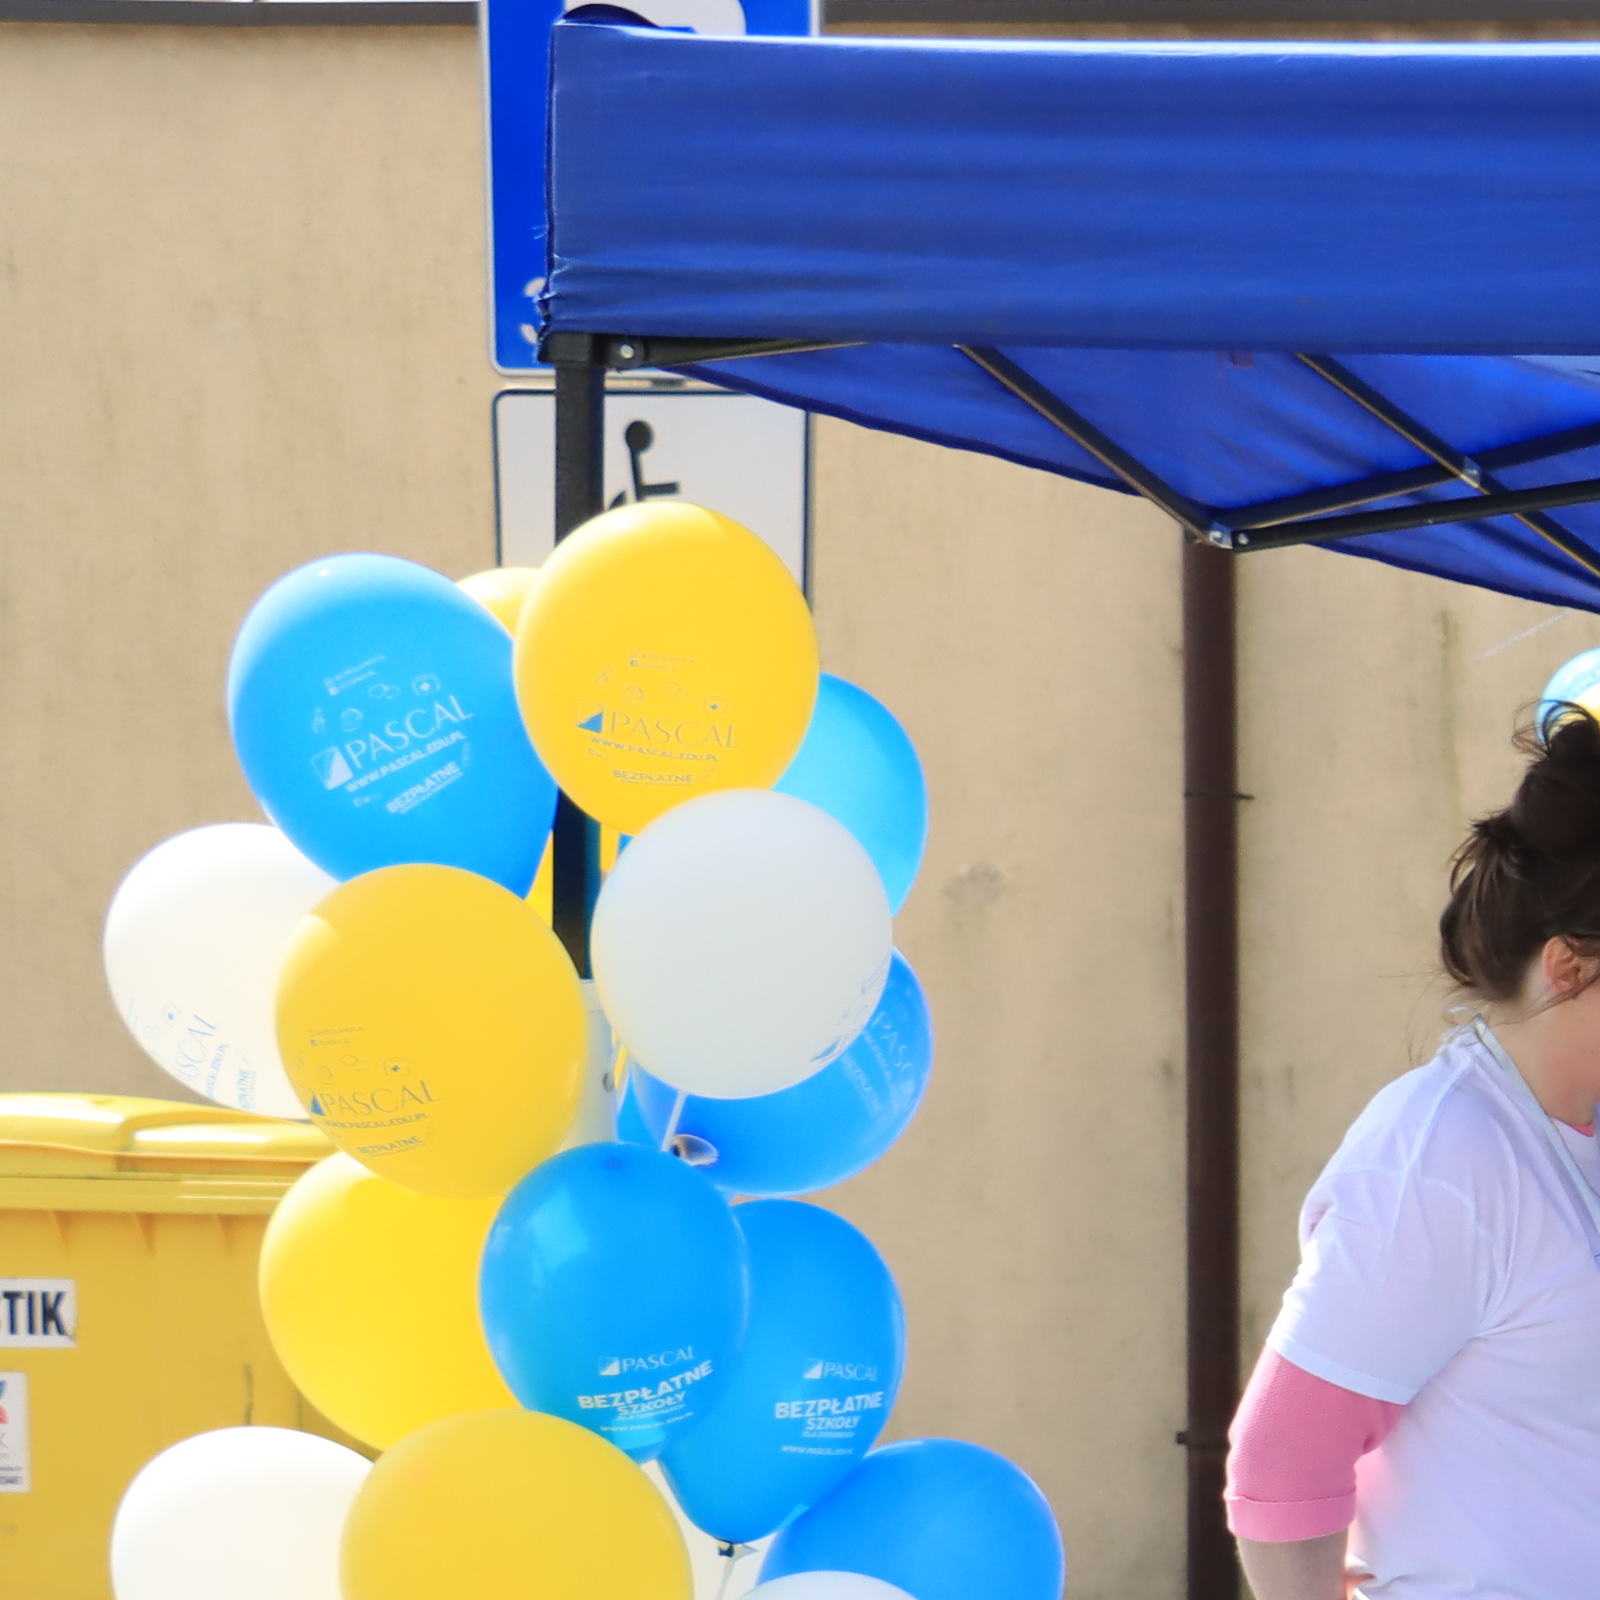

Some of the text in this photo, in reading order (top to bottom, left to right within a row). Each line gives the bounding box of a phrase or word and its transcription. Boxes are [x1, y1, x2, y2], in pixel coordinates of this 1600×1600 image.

[345, 694, 475, 769] PASCAL
[610, 711, 739, 748] PASCAL
[320, 1079, 444, 1116] PASCAL
[0, 1290, 67, 1337] TIK
[622, 1345, 694, 1373] PASCAL
[823, 1361, 878, 1381] PASCAL
[577, 1359, 714, 1409] BEZPŁATNE
[617, 1391, 686, 1416] SZKOŁY
[775, 1391, 884, 1419] BEZPŁATNE
[806, 1415, 861, 1431] SZKOŁY
